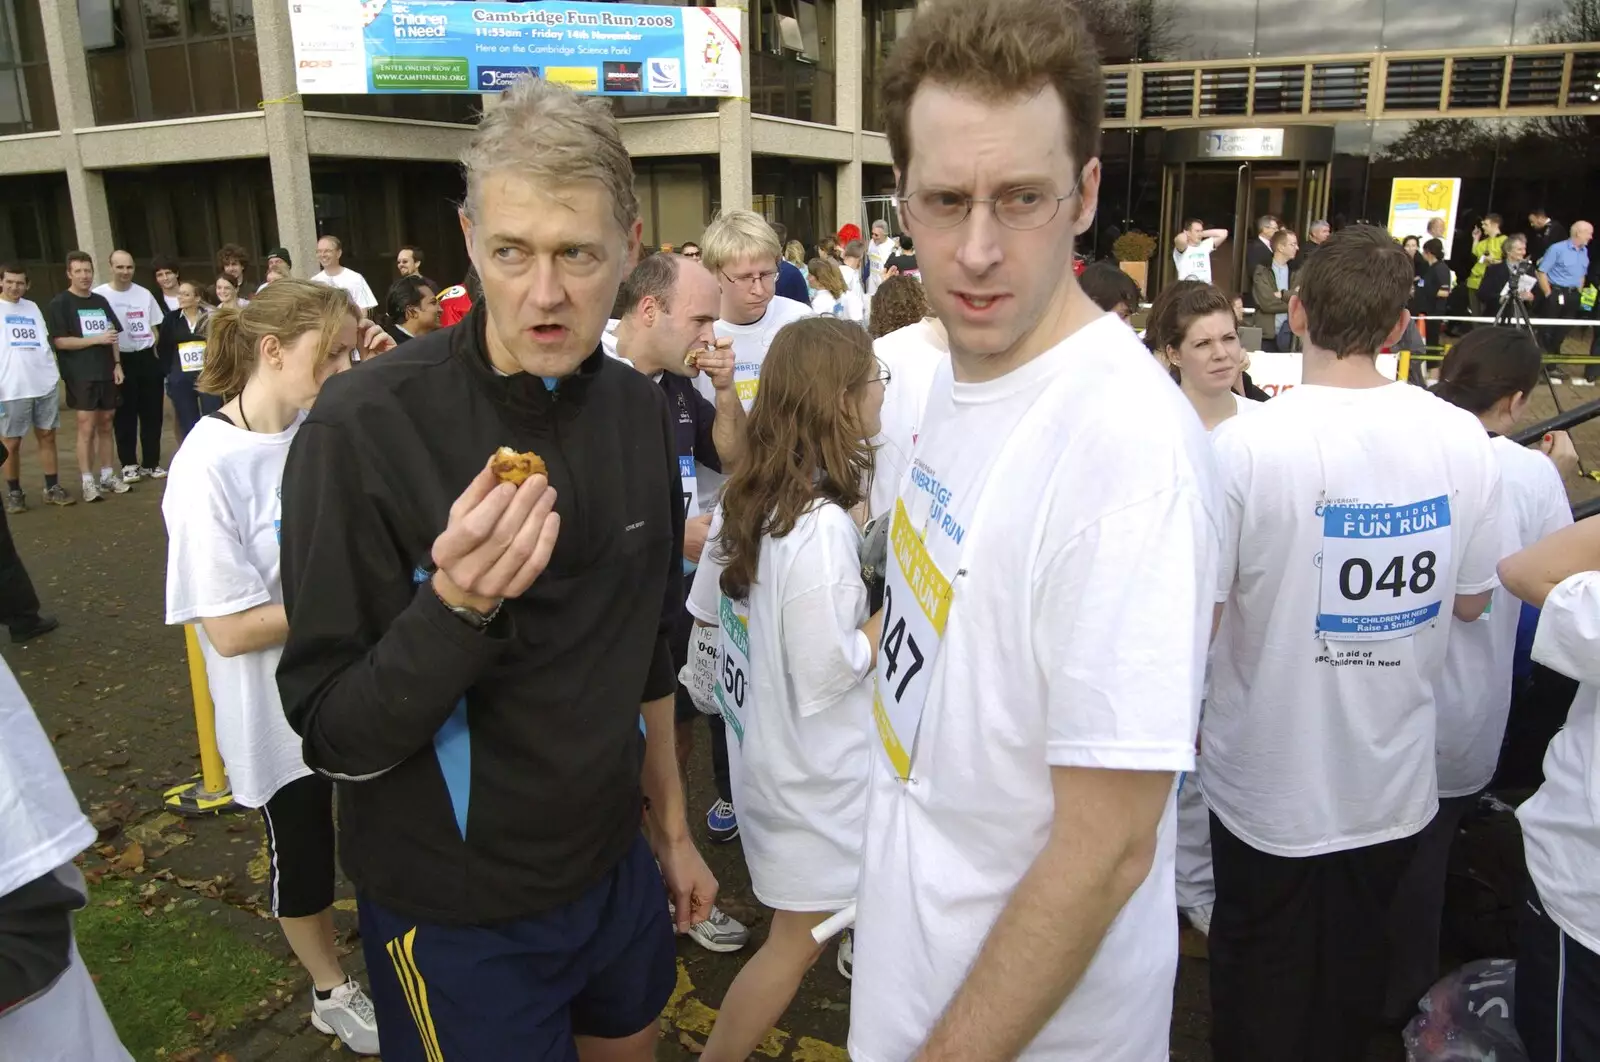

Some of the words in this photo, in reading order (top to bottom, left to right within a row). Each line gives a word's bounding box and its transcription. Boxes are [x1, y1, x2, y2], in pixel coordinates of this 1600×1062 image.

[393, 14, 448, 25] Children
[474, 9, 563, 26] Cambridge
[567, 11, 598, 24] Fun
[602, 13, 633, 25] Run
[637, 16, 673, 27] 2008
[475, 28, 522, 37] 11:55am
[531, 29, 564, 40] Friday
[567, 30, 589, 40] 14th
[591, 31, 642, 40] November
[475, 43, 497, 53] Here
[512, 44, 526, 53] the
[528, 44, 575, 56] Cambridge
[578, 45, 609, 55] Science
[611, 46, 631, 55] Park!
[376, 73, 466, 81] WWW.CAMFUNRUN.ORG
[85, 320, 105, 331] 088
[12, 328, 36, 339] 088
[1344, 503, 1436, 520] CAMBRIDGE
[941, 513, 965, 545] RUN
[1343, 521, 1391, 536] FUN
[1400, 512, 1437, 534] RUN
[1339, 550, 1437, 601] 048
[912, 565, 940, 619] RUN
[1360, 614, 1401, 624] CHILDREN
[1402, 612, 1410, 620] IN
[1411, 608, 1428, 618] NEED
[1357, 624, 1381, 632] Raise
[1391, 618, 1416, 630] Smile!
[1346, 650, 1360, 658] aid
[1330, 658, 1363, 667] Children
